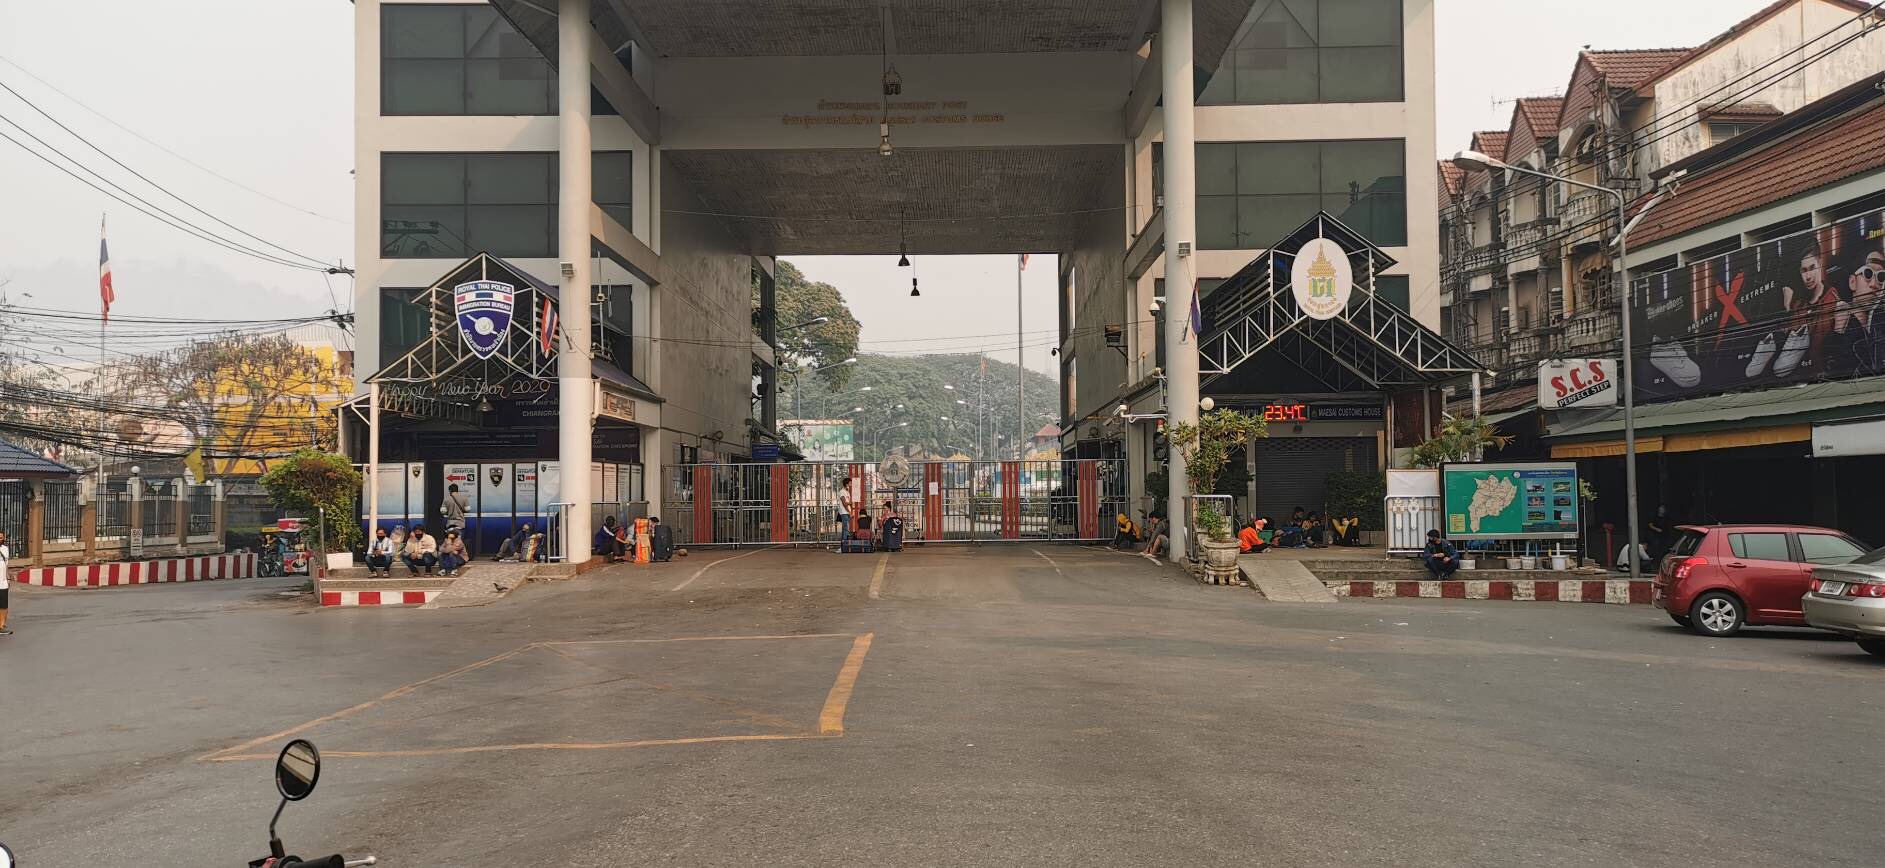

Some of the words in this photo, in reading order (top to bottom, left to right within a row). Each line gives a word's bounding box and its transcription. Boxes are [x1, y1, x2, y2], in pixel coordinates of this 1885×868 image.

[457, 284, 477, 294] ROYAL
[490, 283, 512, 294] POLICE
[458, 301, 491, 312] IMMIGRATION
[491, 301, 511, 311] BUREAU
[1714, 271, 1749, 350] X
[1740, 280, 1775, 304] EXTREME
[512, 379, 551, 394] 2020
[1550, 361, 1605, 398] S.C.S
[1559, 391, 1591, 407] PERFECT
[1592, 381, 1609, 394] STEP
[1318, 407, 1337, 418] MAESAI
[1338, 407, 1363, 418] CUSTOMS
[1363, 407, 1382, 417] HOUSE
